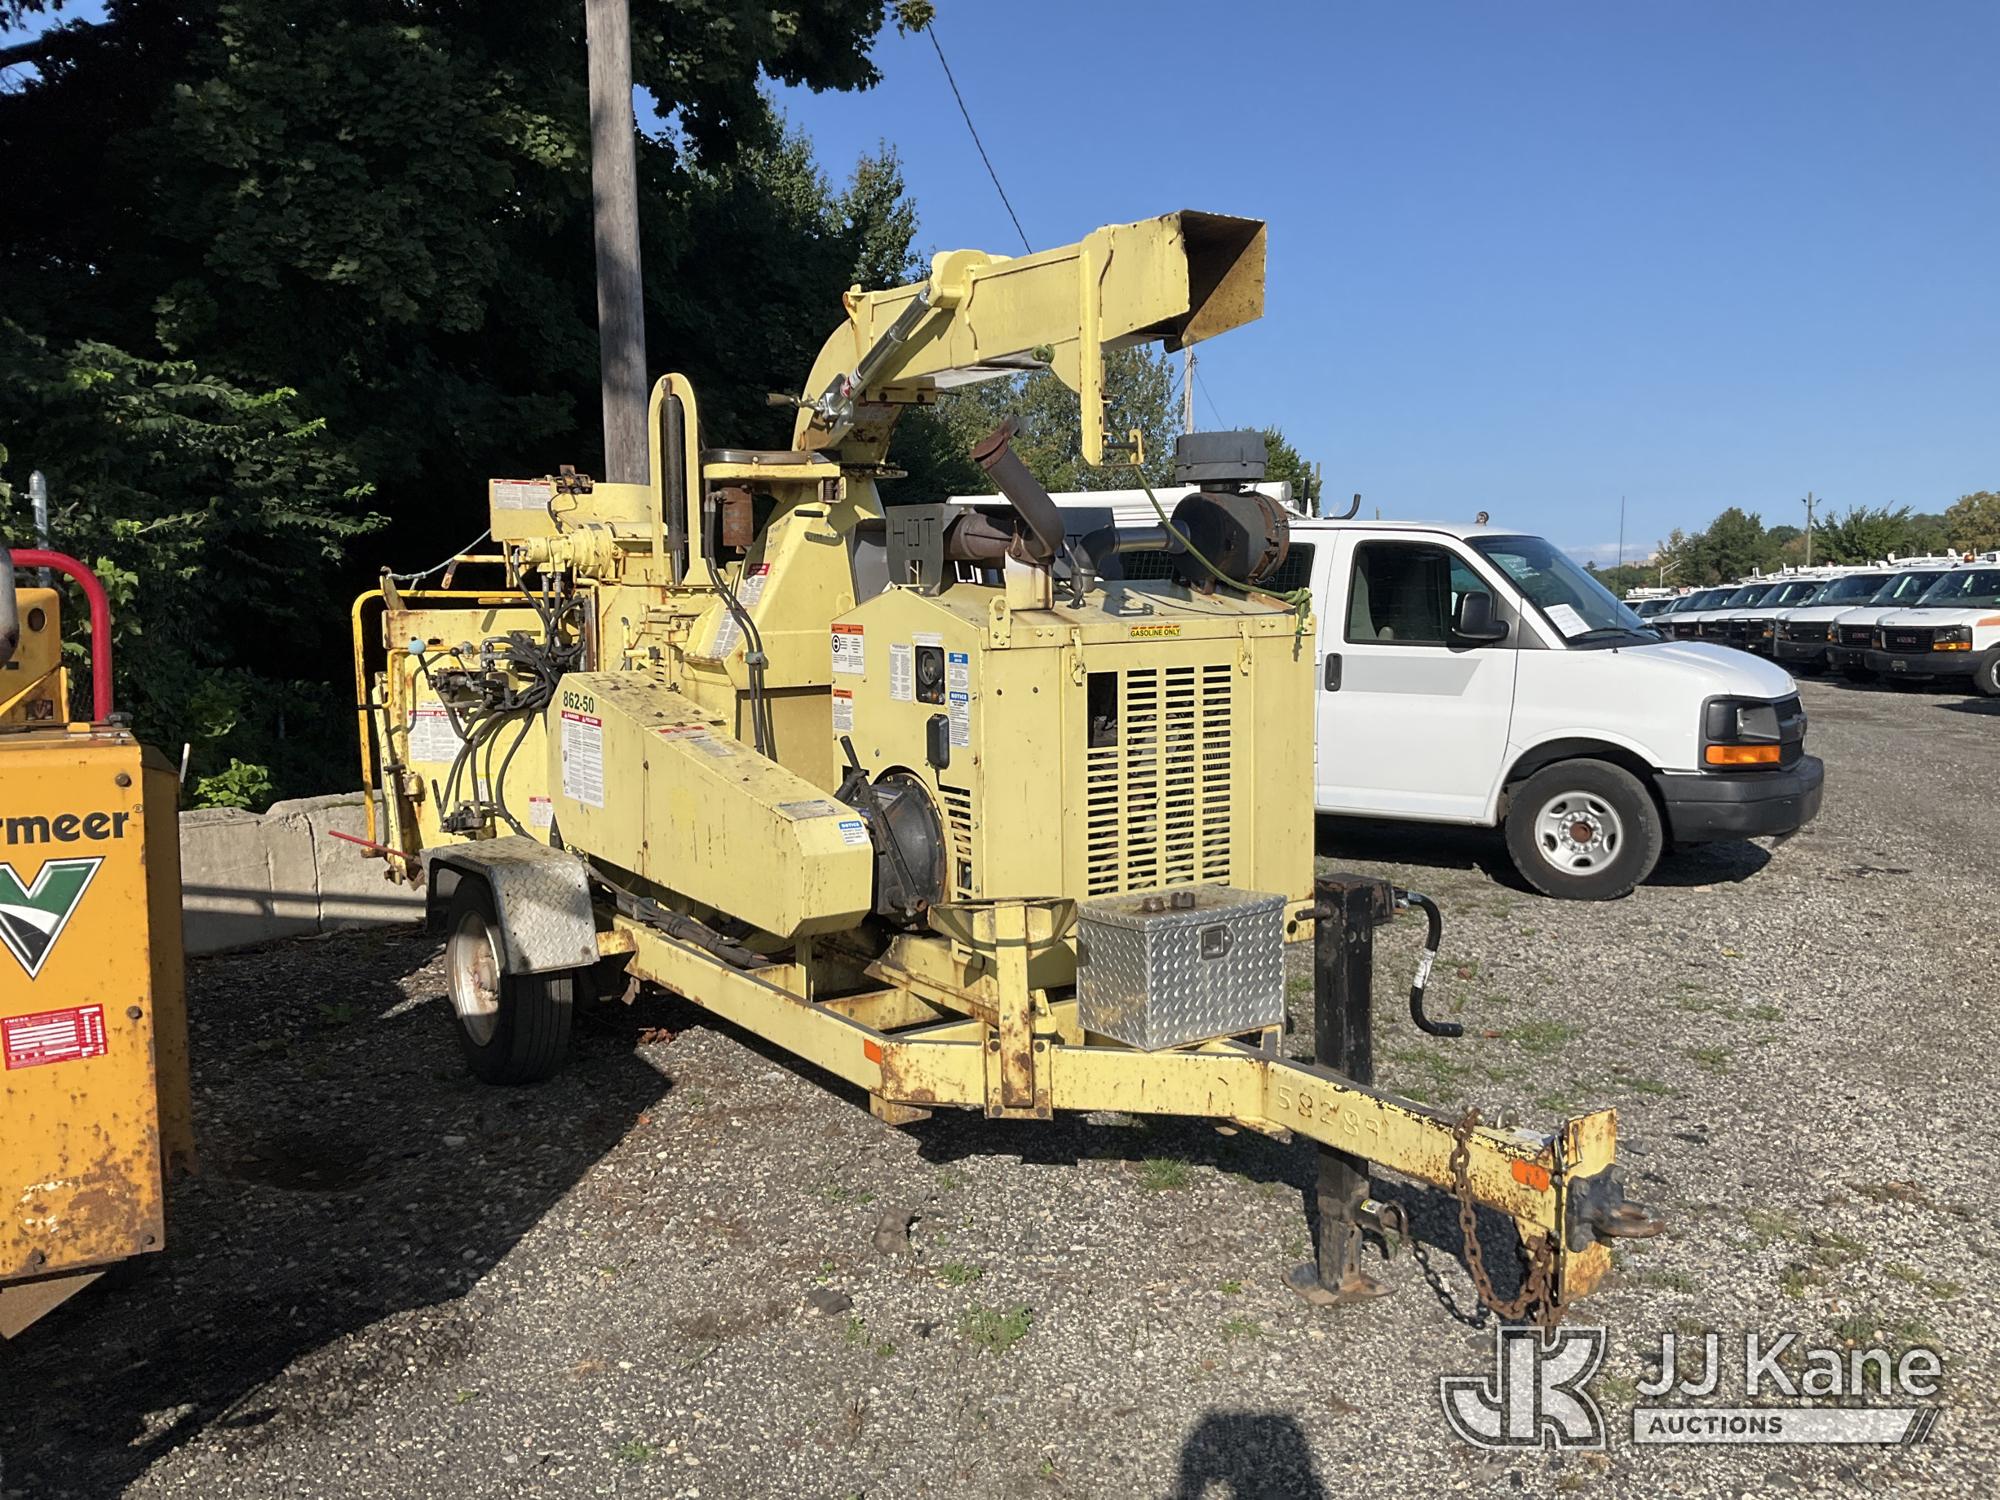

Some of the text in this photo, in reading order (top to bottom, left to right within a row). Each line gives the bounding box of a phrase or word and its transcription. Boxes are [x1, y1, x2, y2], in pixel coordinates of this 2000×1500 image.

[892, 517, 936, 547] HOT
[1130, 628, 1181, 637] GASOLINE ONLY
[563, 690, 595, 714] 862-50
[0, 811, 129, 845] meer
